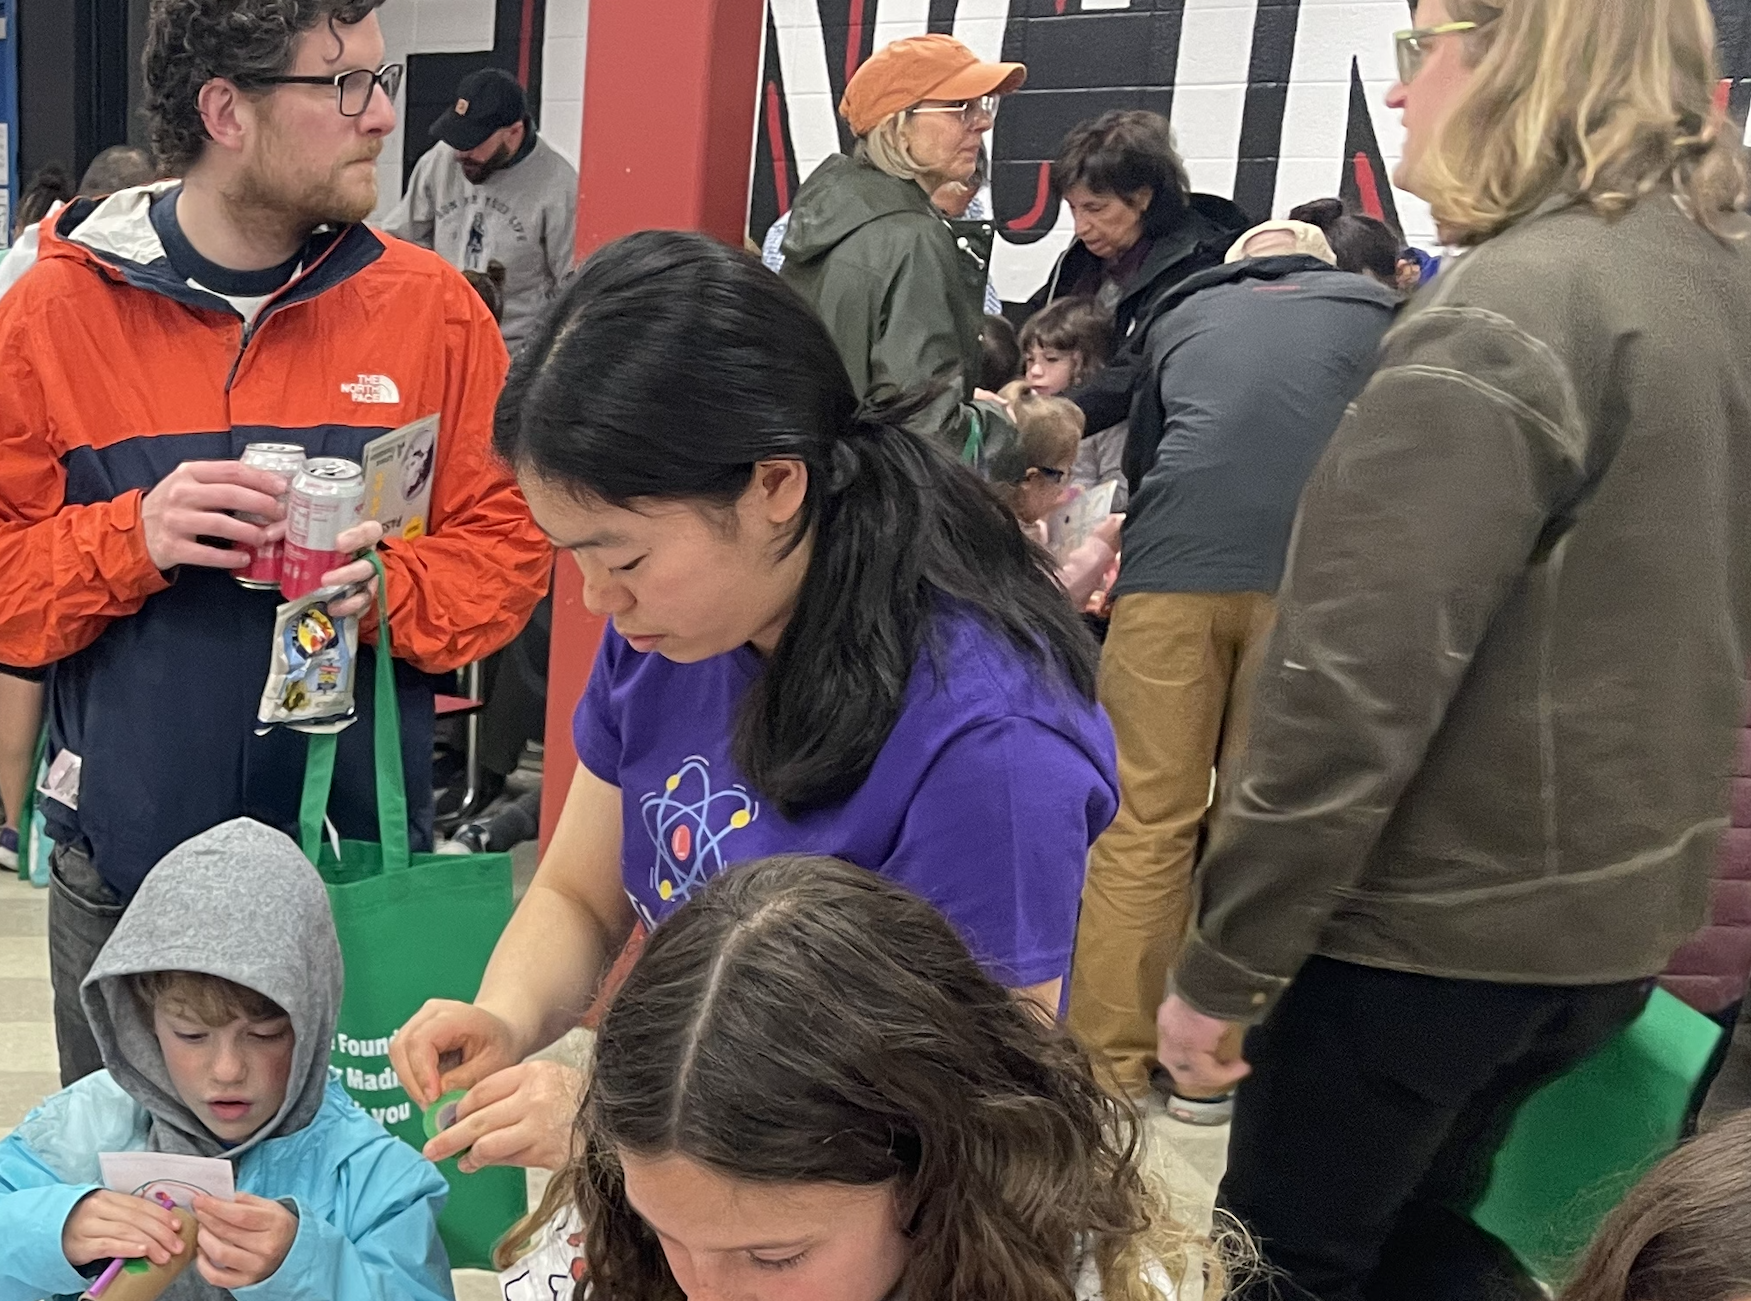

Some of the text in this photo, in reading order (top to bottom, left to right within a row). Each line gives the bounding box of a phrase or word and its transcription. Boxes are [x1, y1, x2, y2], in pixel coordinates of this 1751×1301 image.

[357, 374, 381, 384] THE
[340, 383, 381, 394] NORTH
[351, 393, 381, 404] FACE
[370, 1102, 411, 1126] you
